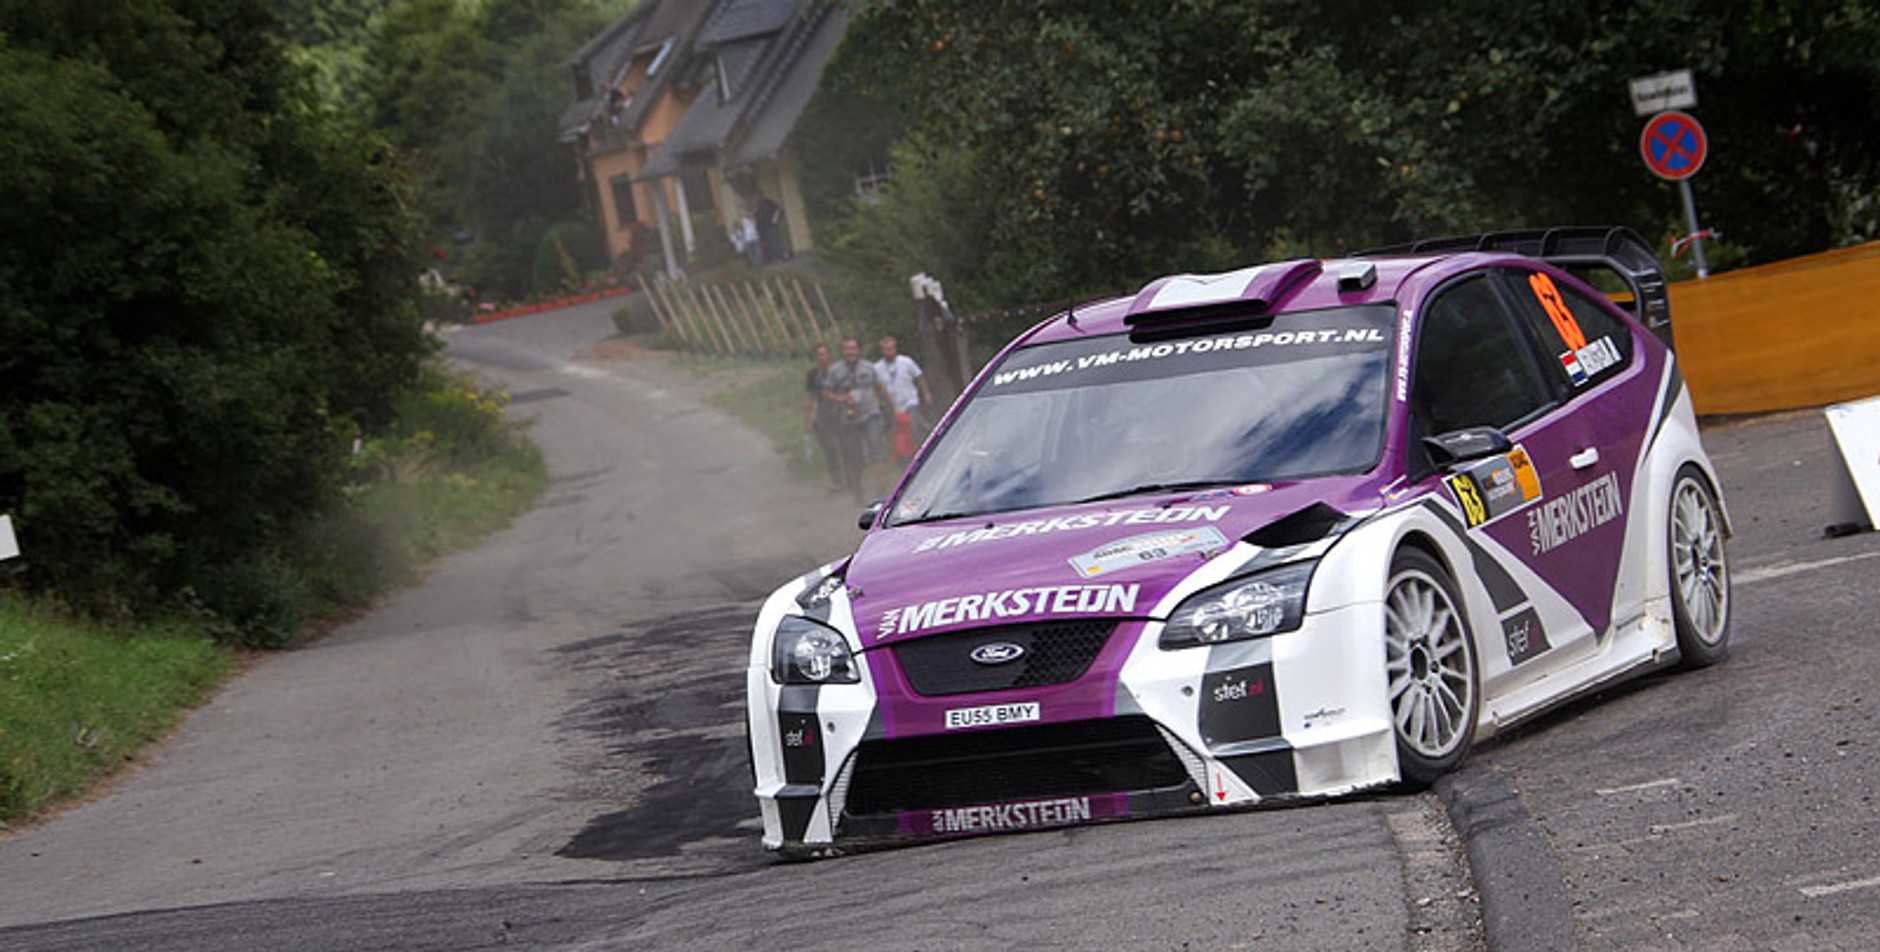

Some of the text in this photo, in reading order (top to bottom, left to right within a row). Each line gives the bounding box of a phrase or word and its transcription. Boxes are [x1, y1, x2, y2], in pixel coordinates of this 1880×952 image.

[1528, 271, 1588, 352] 63
[993, 328, 1385, 387] WWW.VM-MOTORSPORT.NL
[1452, 474, 1486, 527] 63
[1138, 547, 1168, 561] 63
[981, 644, 1012, 660] Ford
[950, 704, 1035, 727] EU55 BMY
